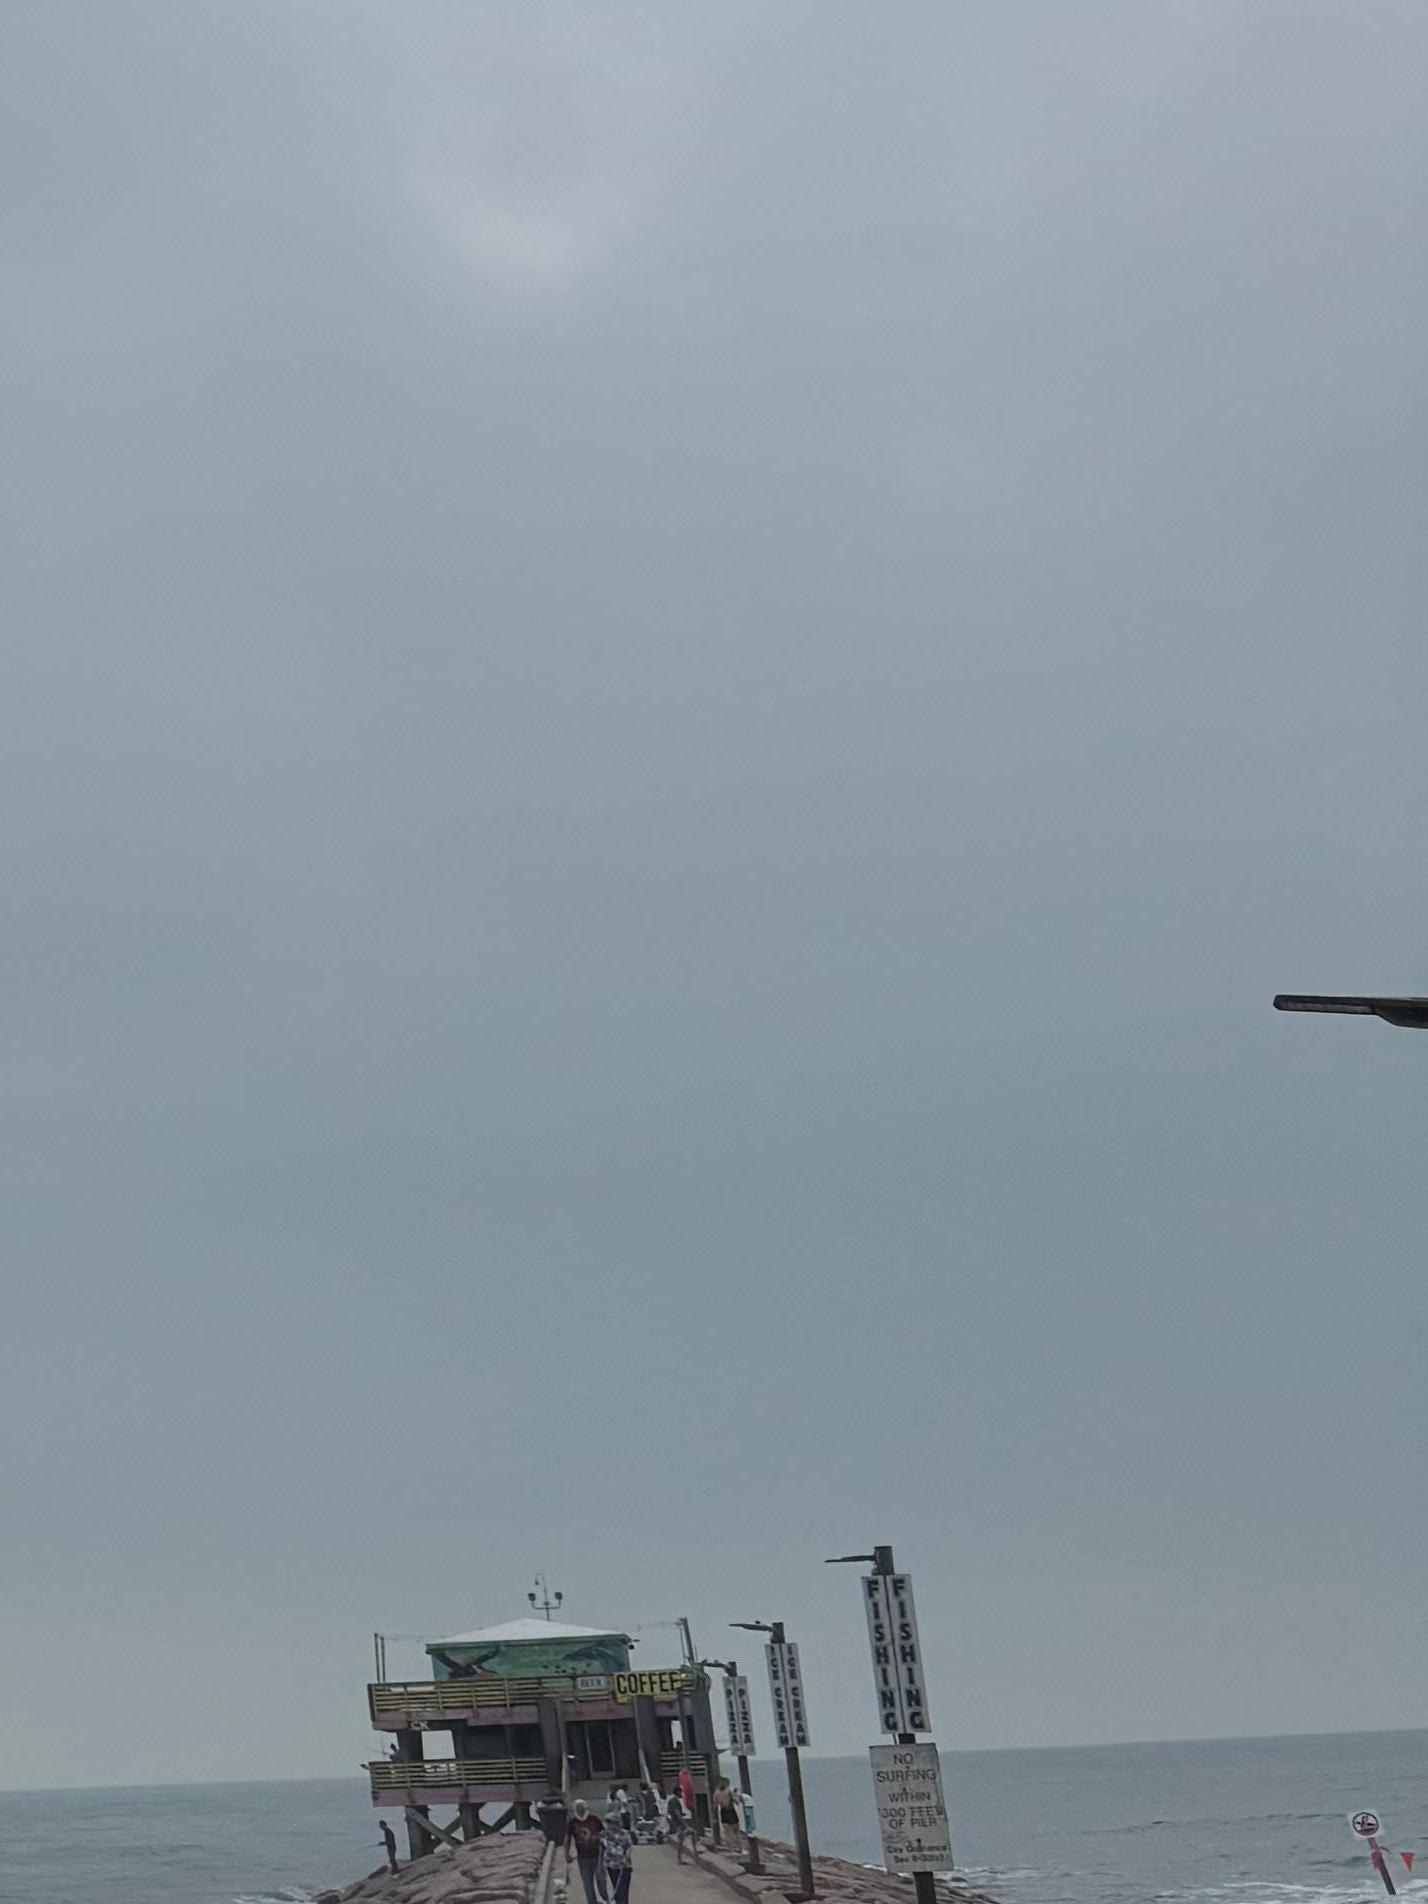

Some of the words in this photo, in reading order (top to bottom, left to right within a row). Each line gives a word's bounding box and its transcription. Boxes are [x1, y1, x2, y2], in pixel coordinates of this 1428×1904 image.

[867, 1579, 898, 1731] FISHING
[892, 1578, 924, 1730] FISHING
[616, 1671, 681, 1694] COFFEE
[893, 1752, 914, 1765] NO
[877, 1769, 937, 1783] SURFING
[888, 1819, 905, 1830] OF
[910, 1818, 937, 1828] PIER
